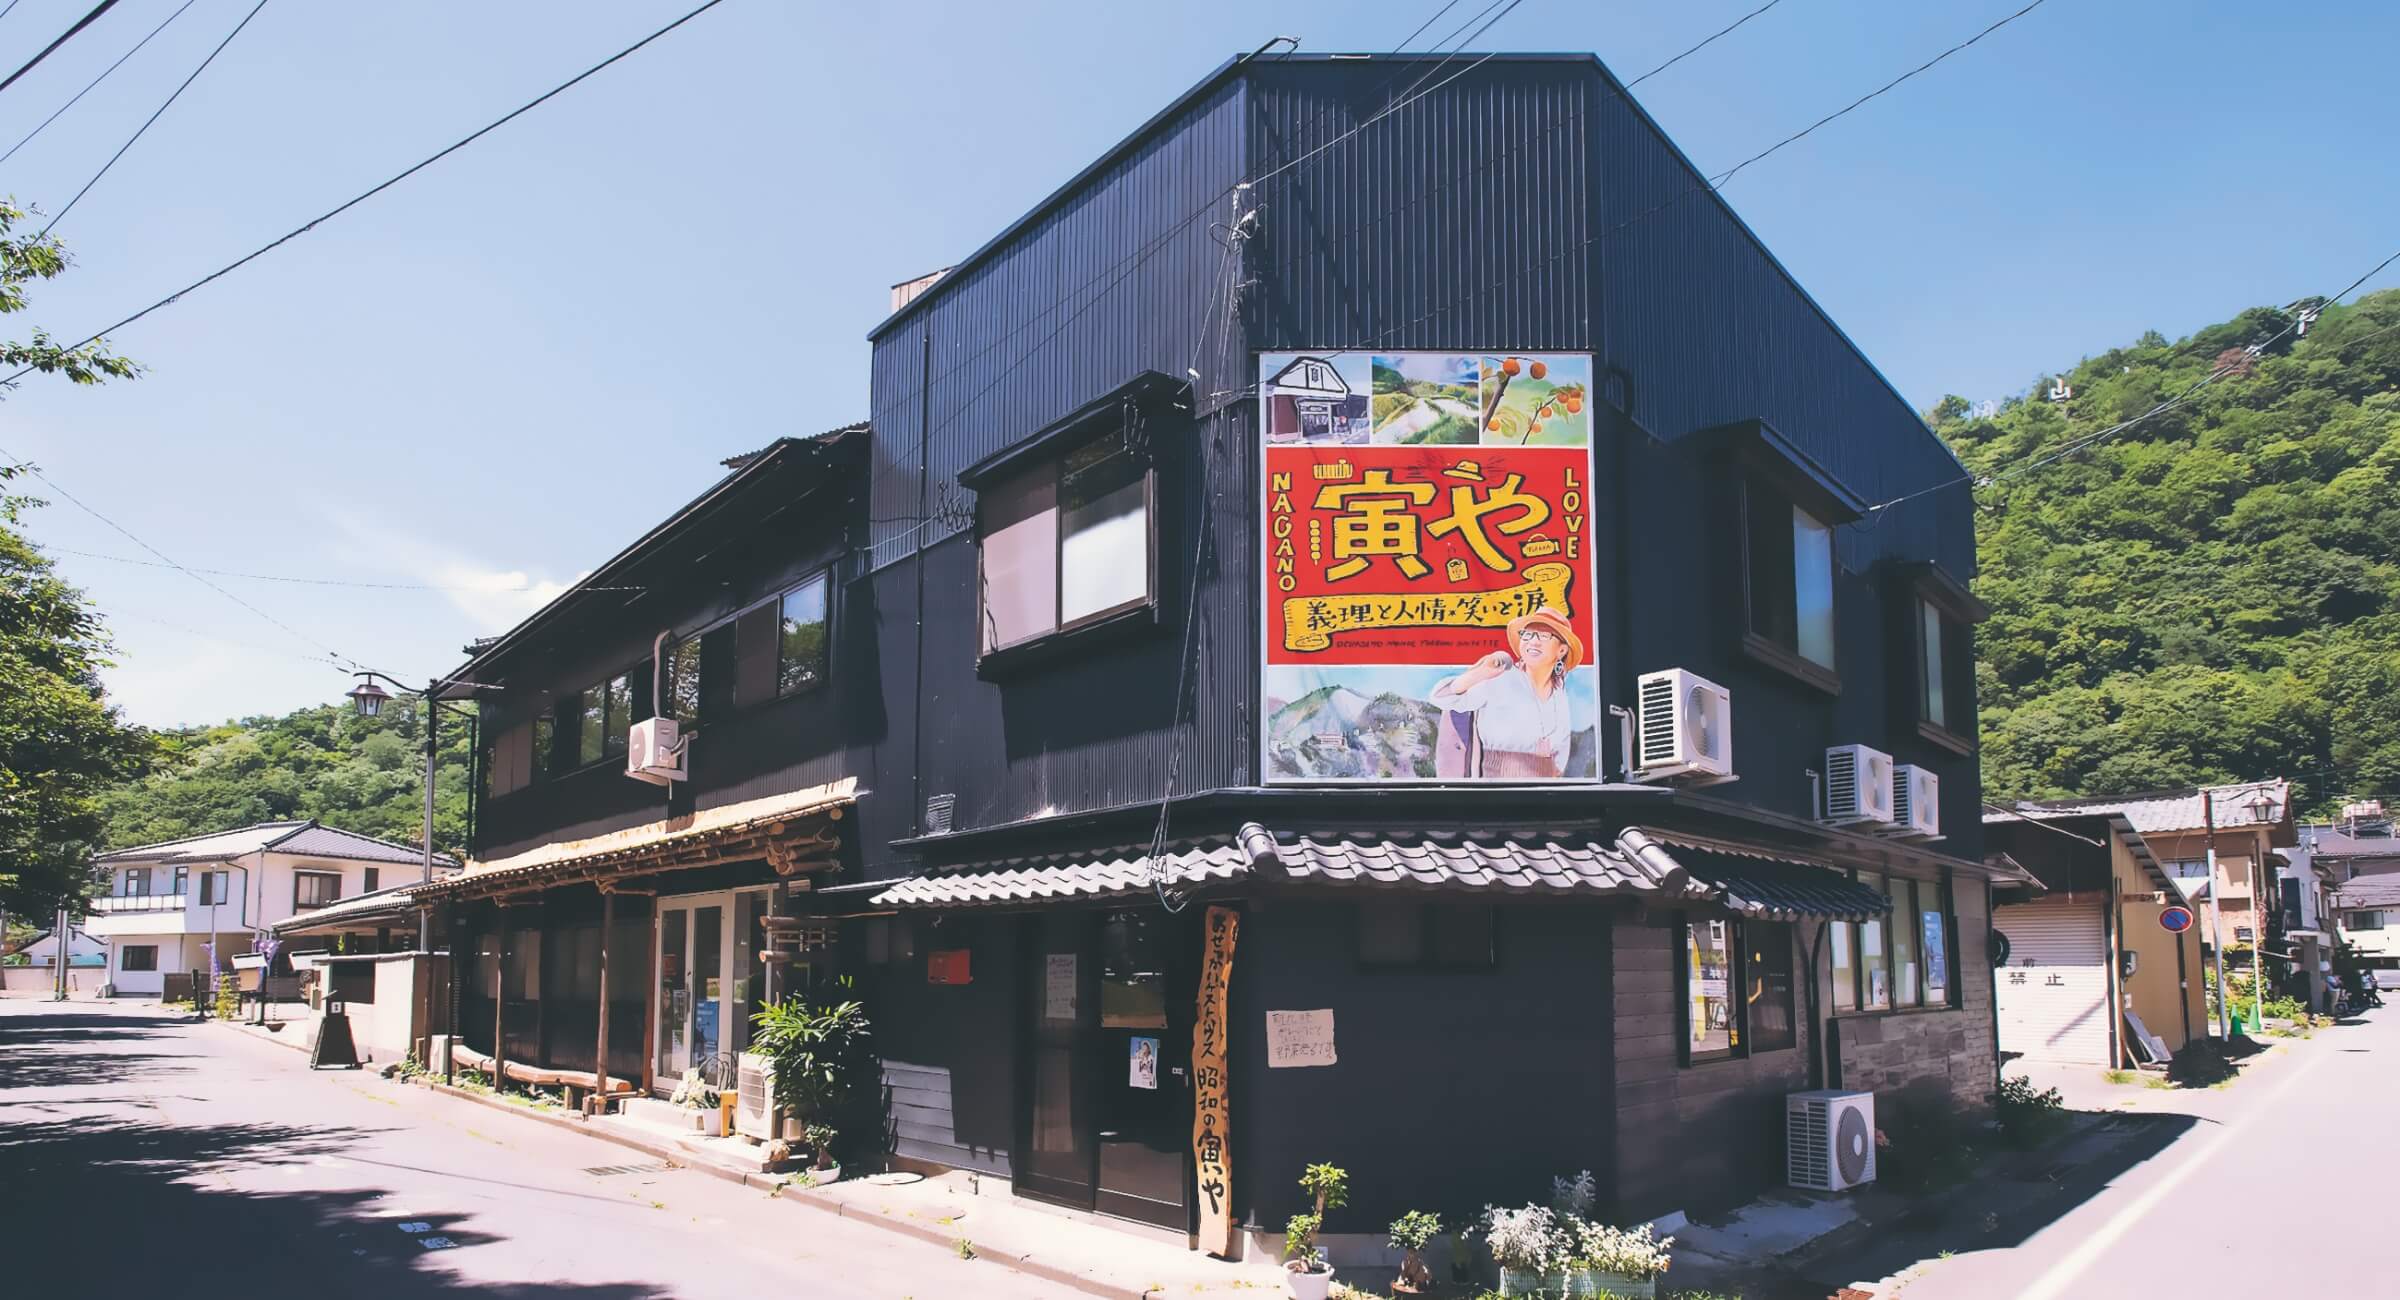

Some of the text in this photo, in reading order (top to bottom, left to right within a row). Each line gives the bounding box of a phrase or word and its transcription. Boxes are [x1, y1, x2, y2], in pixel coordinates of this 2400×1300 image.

[1271, 471, 1296, 592] NAGANO
[1312, 468, 1552, 584] 寅や
[1561, 467, 1584, 559] LOVE
